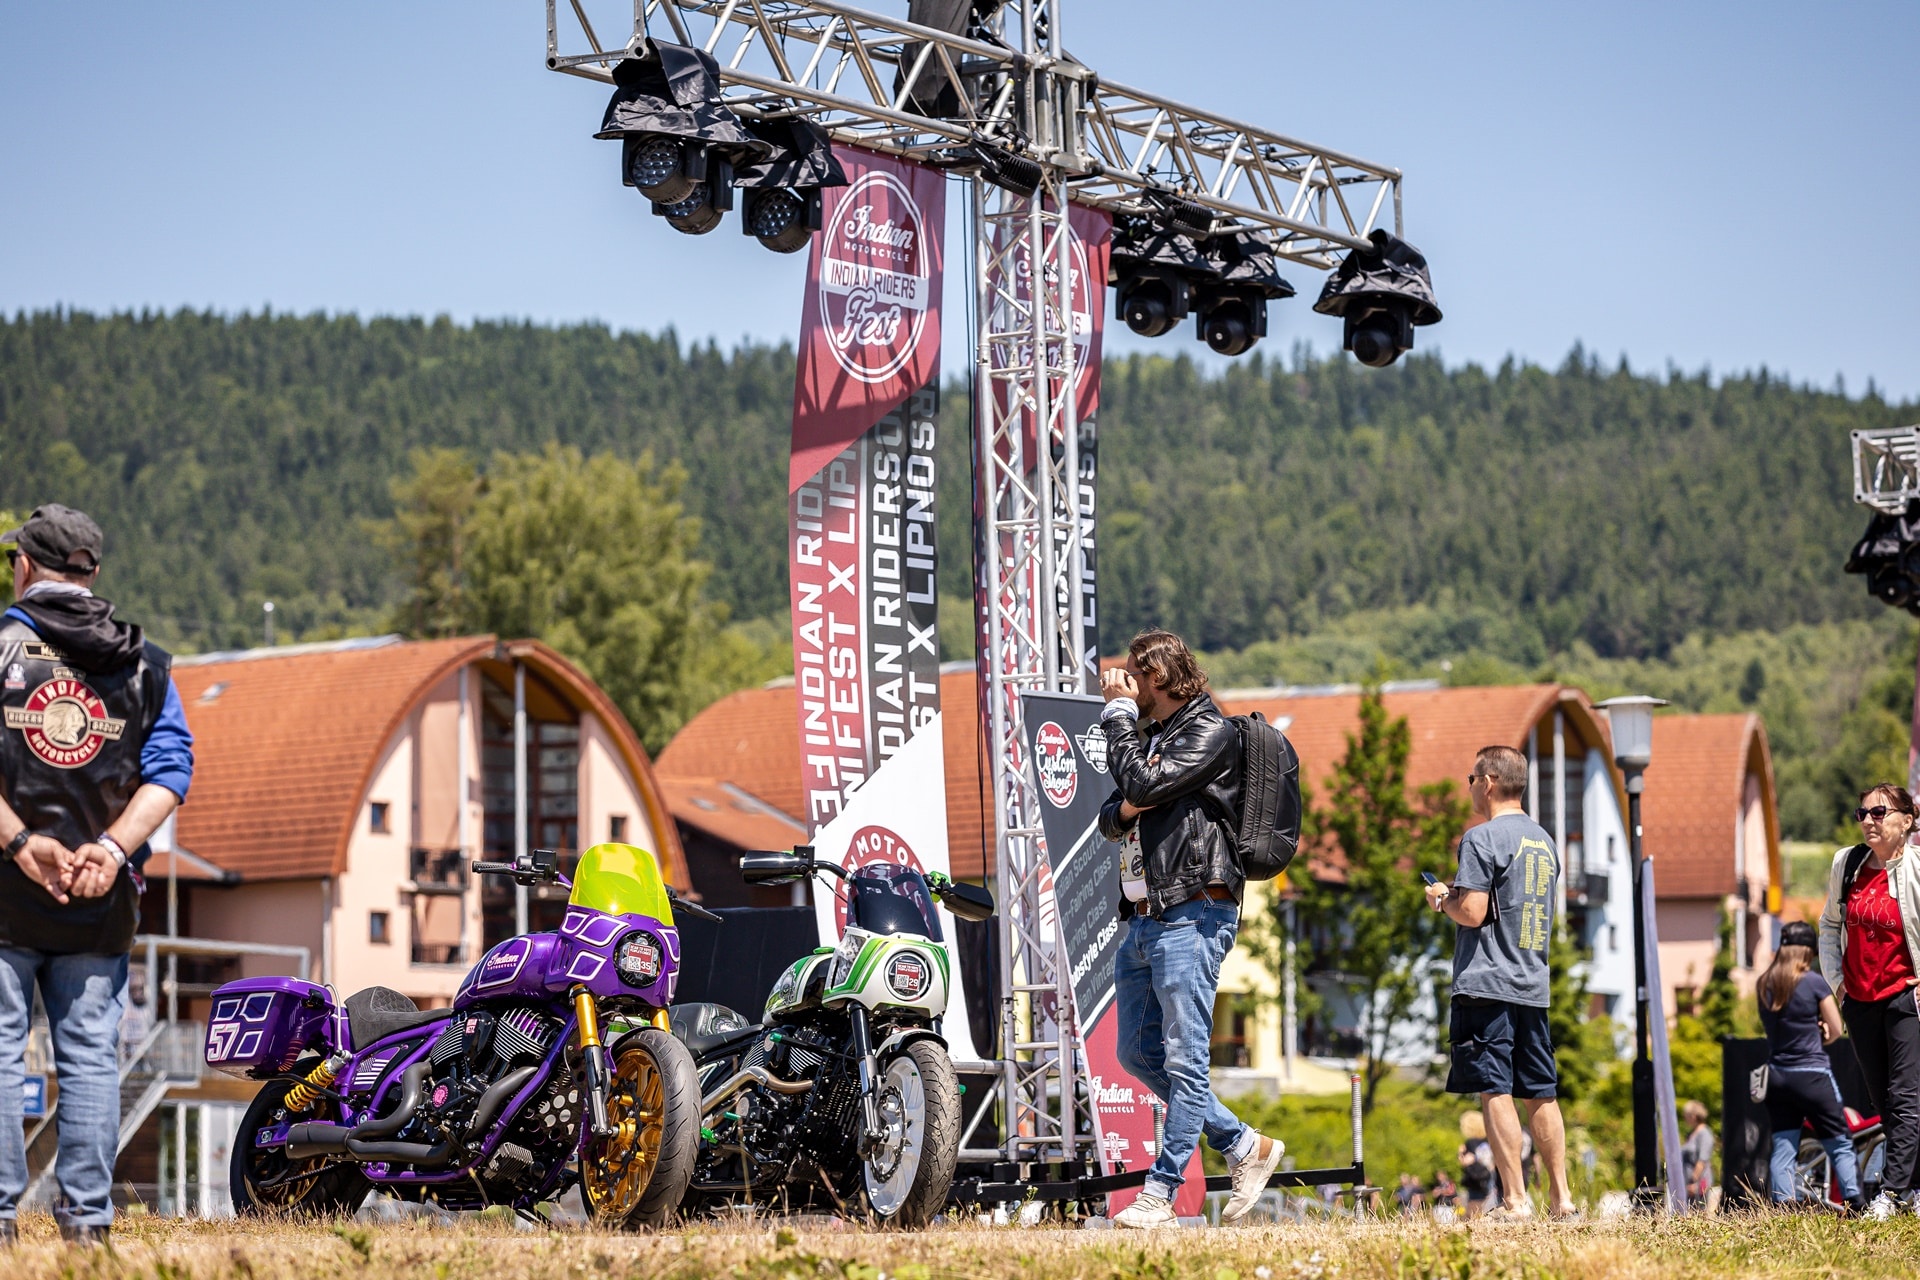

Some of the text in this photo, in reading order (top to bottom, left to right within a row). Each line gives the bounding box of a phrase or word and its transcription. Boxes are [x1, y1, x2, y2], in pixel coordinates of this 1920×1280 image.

[844, 205, 914, 249] Indian
[844, 241, 911, 262] MOTORCYCLE
[831, 263, 916, 300] INDIAN RIDERS
[837, 288, 901, 349] Fest
[828, 450, 857, 544] LIP
[907, 621, 936, 656] X
[797, 582, 830, 746] INDIAN
[37, 680, 100, 709] INDIAN
[873, 643, 905, 762] DIAN
[8, 711, 121, 735] RIDERS GROUP
[30, 732, 98, 763] MOTORCYCLE
[1035, 744, 1077, 773] Custom
[1044, 769, 1073, 790] Show
[1073, 841, 1097, 878] Scout
[1093, 856, 1112, 887] Class
[1087, 896, 1108, 929] Class
[1097, 916, 1118, 952] Class
[487, 952, 520, 966] Indian
[640, 961, 651, 970] 35
[909, 978, 919, 987] 29
[207, 1022, 241, 1062] 57
[1091, 1076, 1135, 1104] Indian
